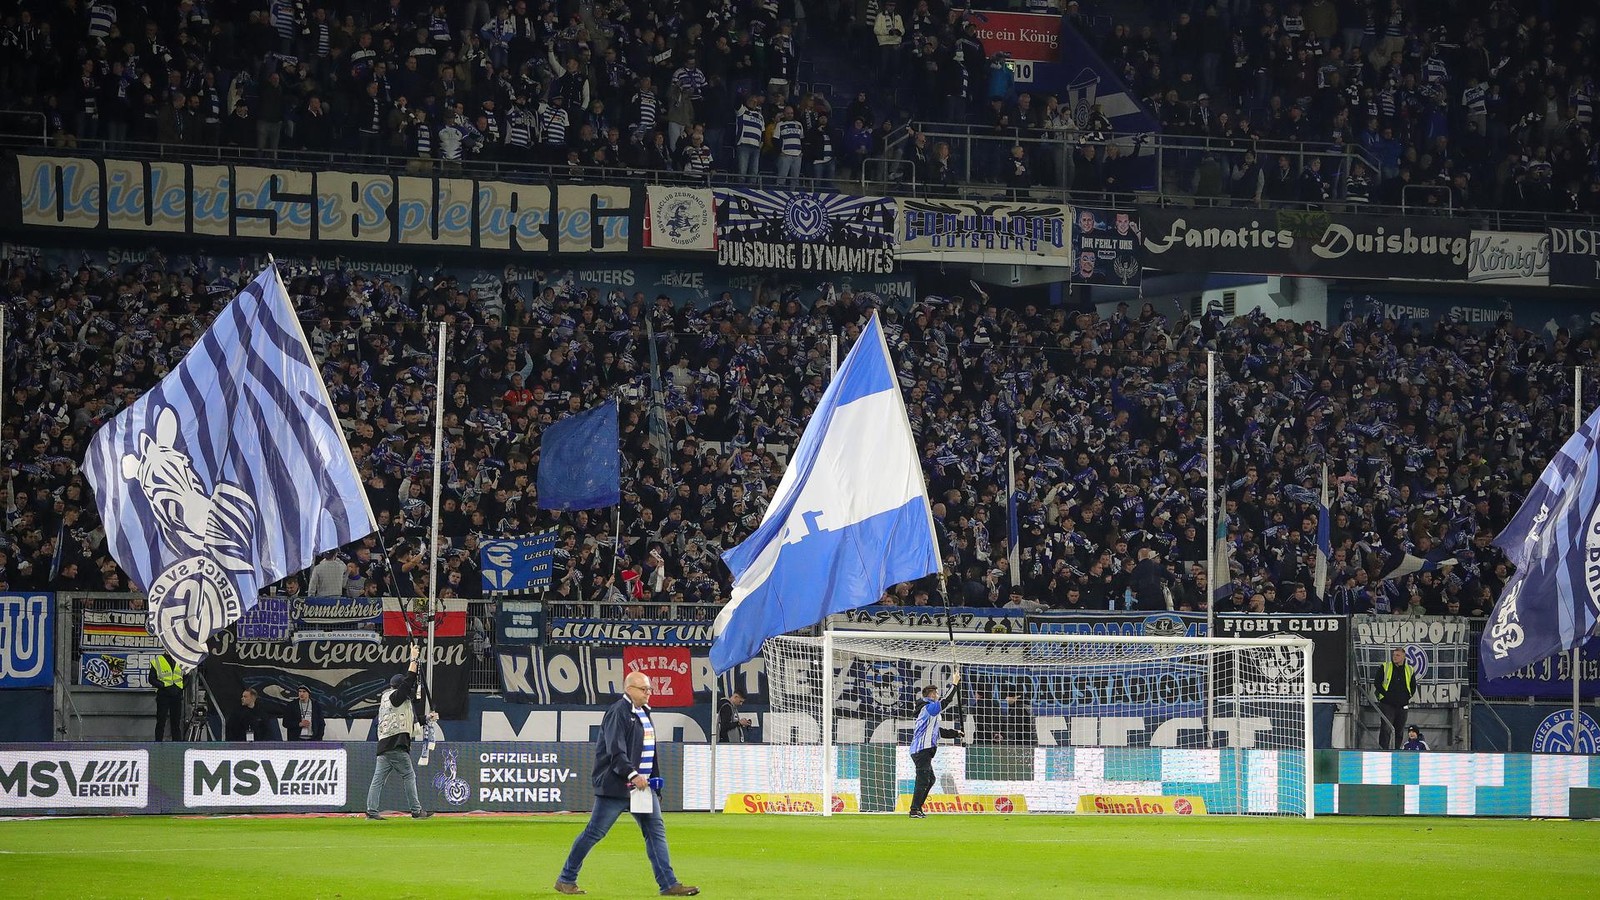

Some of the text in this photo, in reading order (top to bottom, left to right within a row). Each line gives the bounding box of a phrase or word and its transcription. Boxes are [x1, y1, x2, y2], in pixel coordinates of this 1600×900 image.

[996, 31, 1016, 44] ein
[1019, 28, 1059, 49] König
[1017, 65, 1031, 80] 10
[670, 232, 701, 245] DUISBURG
[1095, 238, 1118, 249] FEHLT
[1143, 217, 1467, 266] Fanatics Duisburg
[718, 239, 895, 275] DUISBURG DYNAMITES
[579, 269, 635, 287] WOLTERS
[874, 281, 912, 298] WORM
[1449, 306, 1514, 323] STEININER
[84, 610, 146, 625] SEKTION
[292, 598, 382, 621] Freundeskreis
[237, 625, 288, 638] VERBOT
[1223, 619, 1339, 632] FIGHT CLUB
[211, 629, 302, 664] Proud
[628, 655, 690, 676] ULTRAS
[479, 753, 559, 764] OFFIZIELLER
[479, 769, 577, 783] EXKLUSIV-
[479, 787, 562, 803] PARTNER
[743, 794, 816, 813] Sinalco
[1094, 797, 1164, 815] Sinalco
